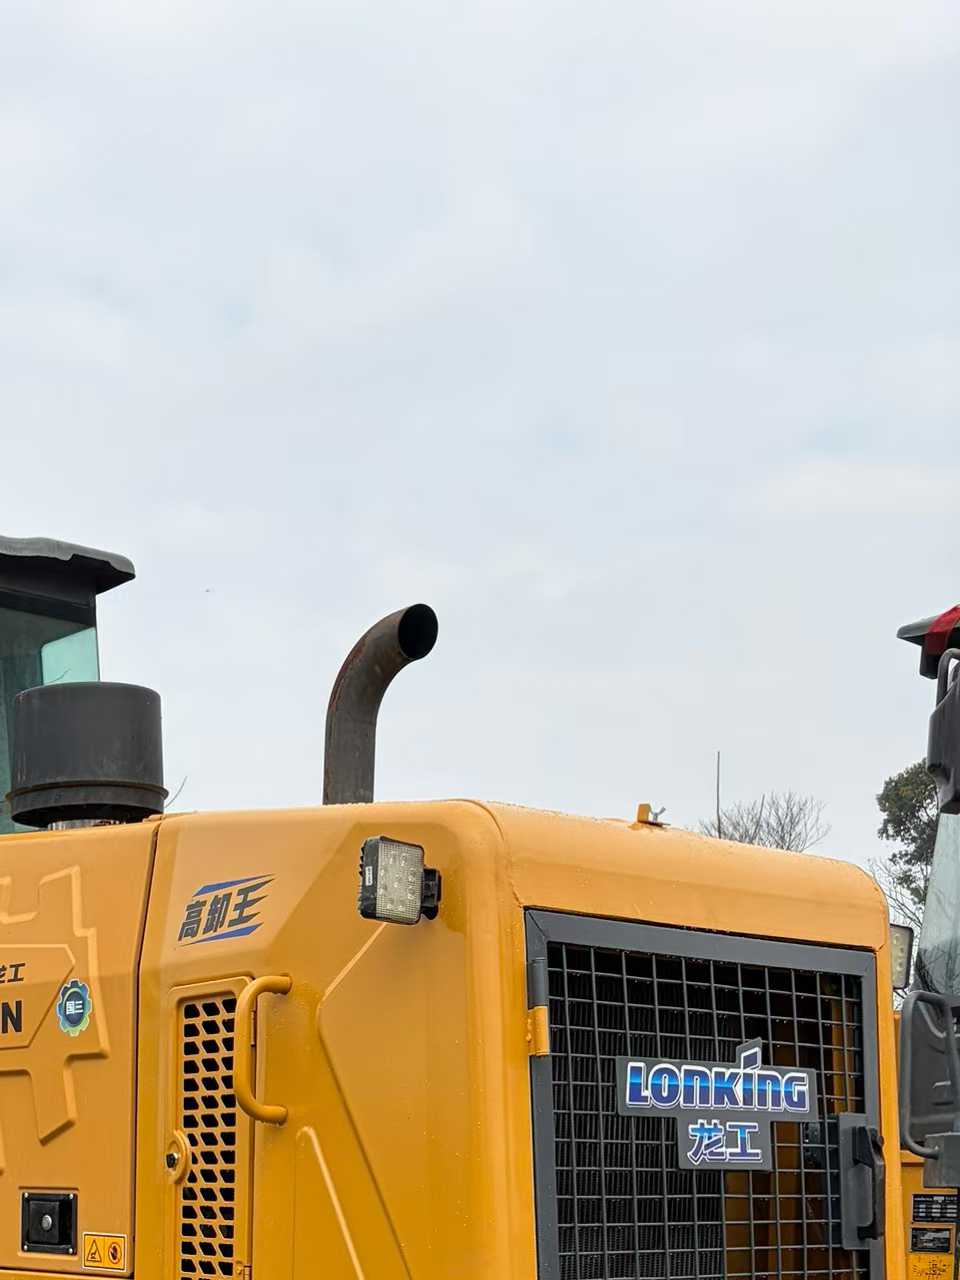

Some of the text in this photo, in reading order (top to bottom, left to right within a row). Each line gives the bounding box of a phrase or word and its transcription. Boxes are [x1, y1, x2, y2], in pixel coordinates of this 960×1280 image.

[177, 877, 276, 942] 高卸王
[687, 1119, 763, 1165] 龙工
